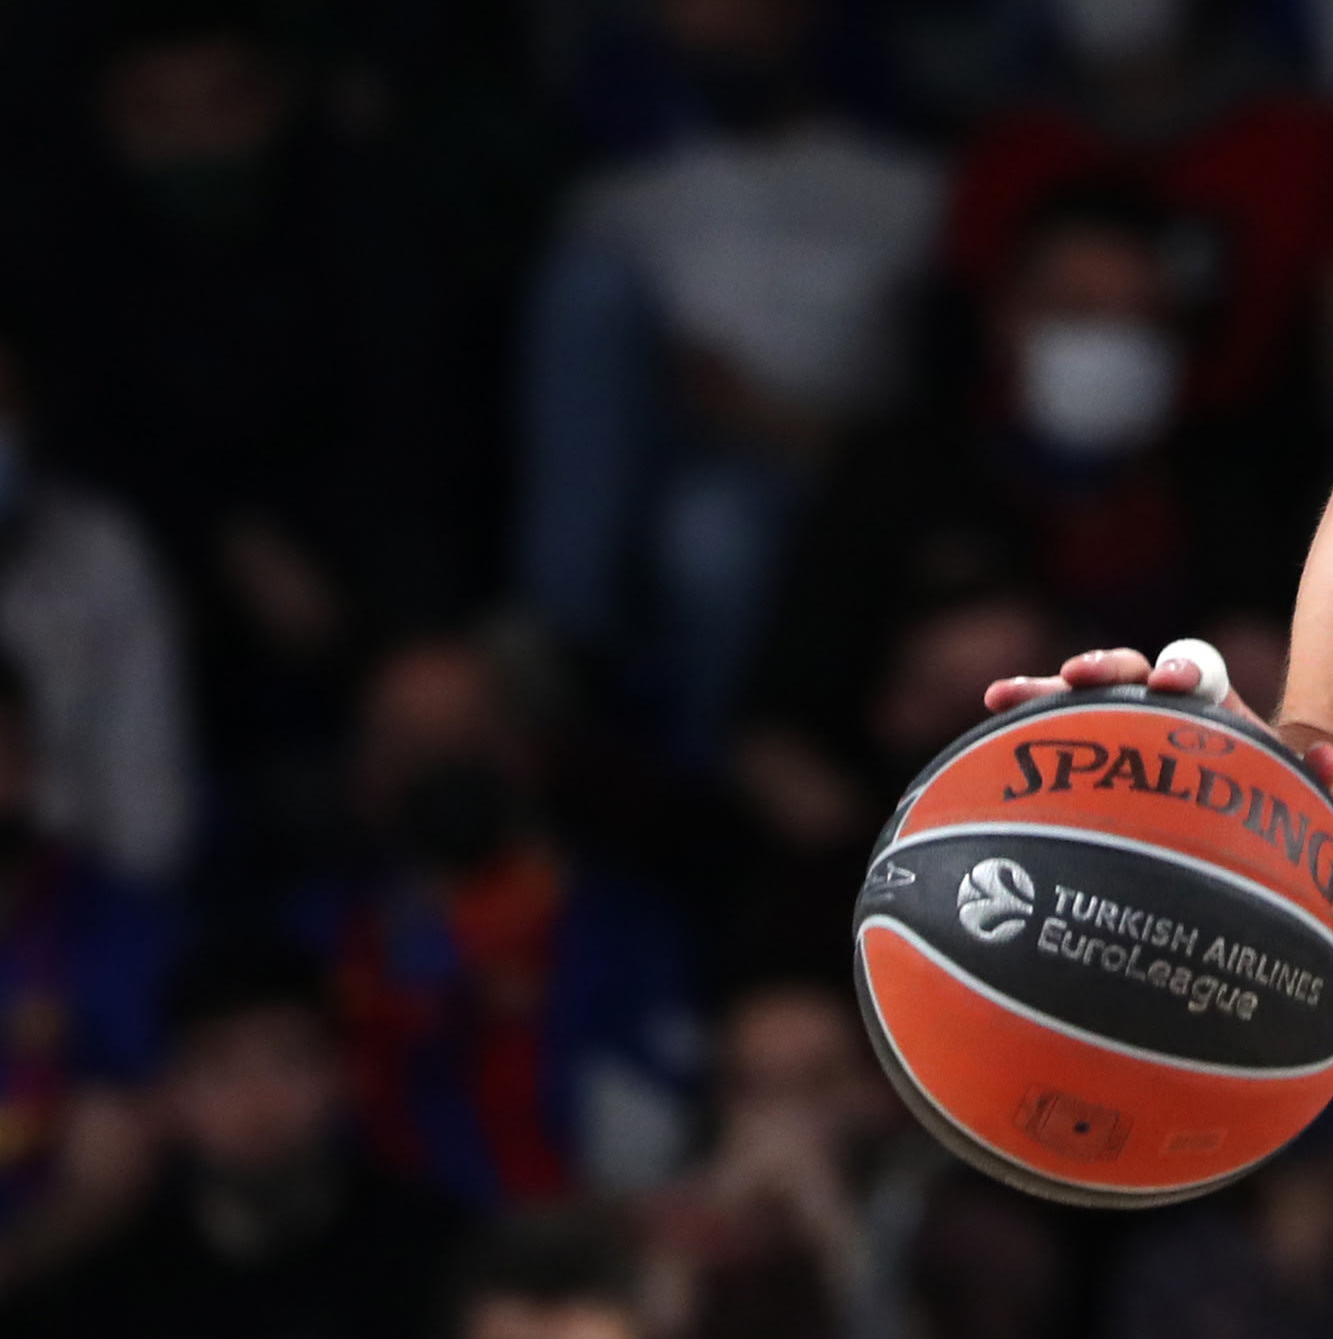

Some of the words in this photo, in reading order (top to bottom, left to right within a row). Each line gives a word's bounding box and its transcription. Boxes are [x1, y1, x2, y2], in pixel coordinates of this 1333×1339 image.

[1037, 917, 1259, 1021] EuroLeague
[1055, 884, 1199, 958] TURKISH
[1202, 936, 1324, 1007] AIRLINES
